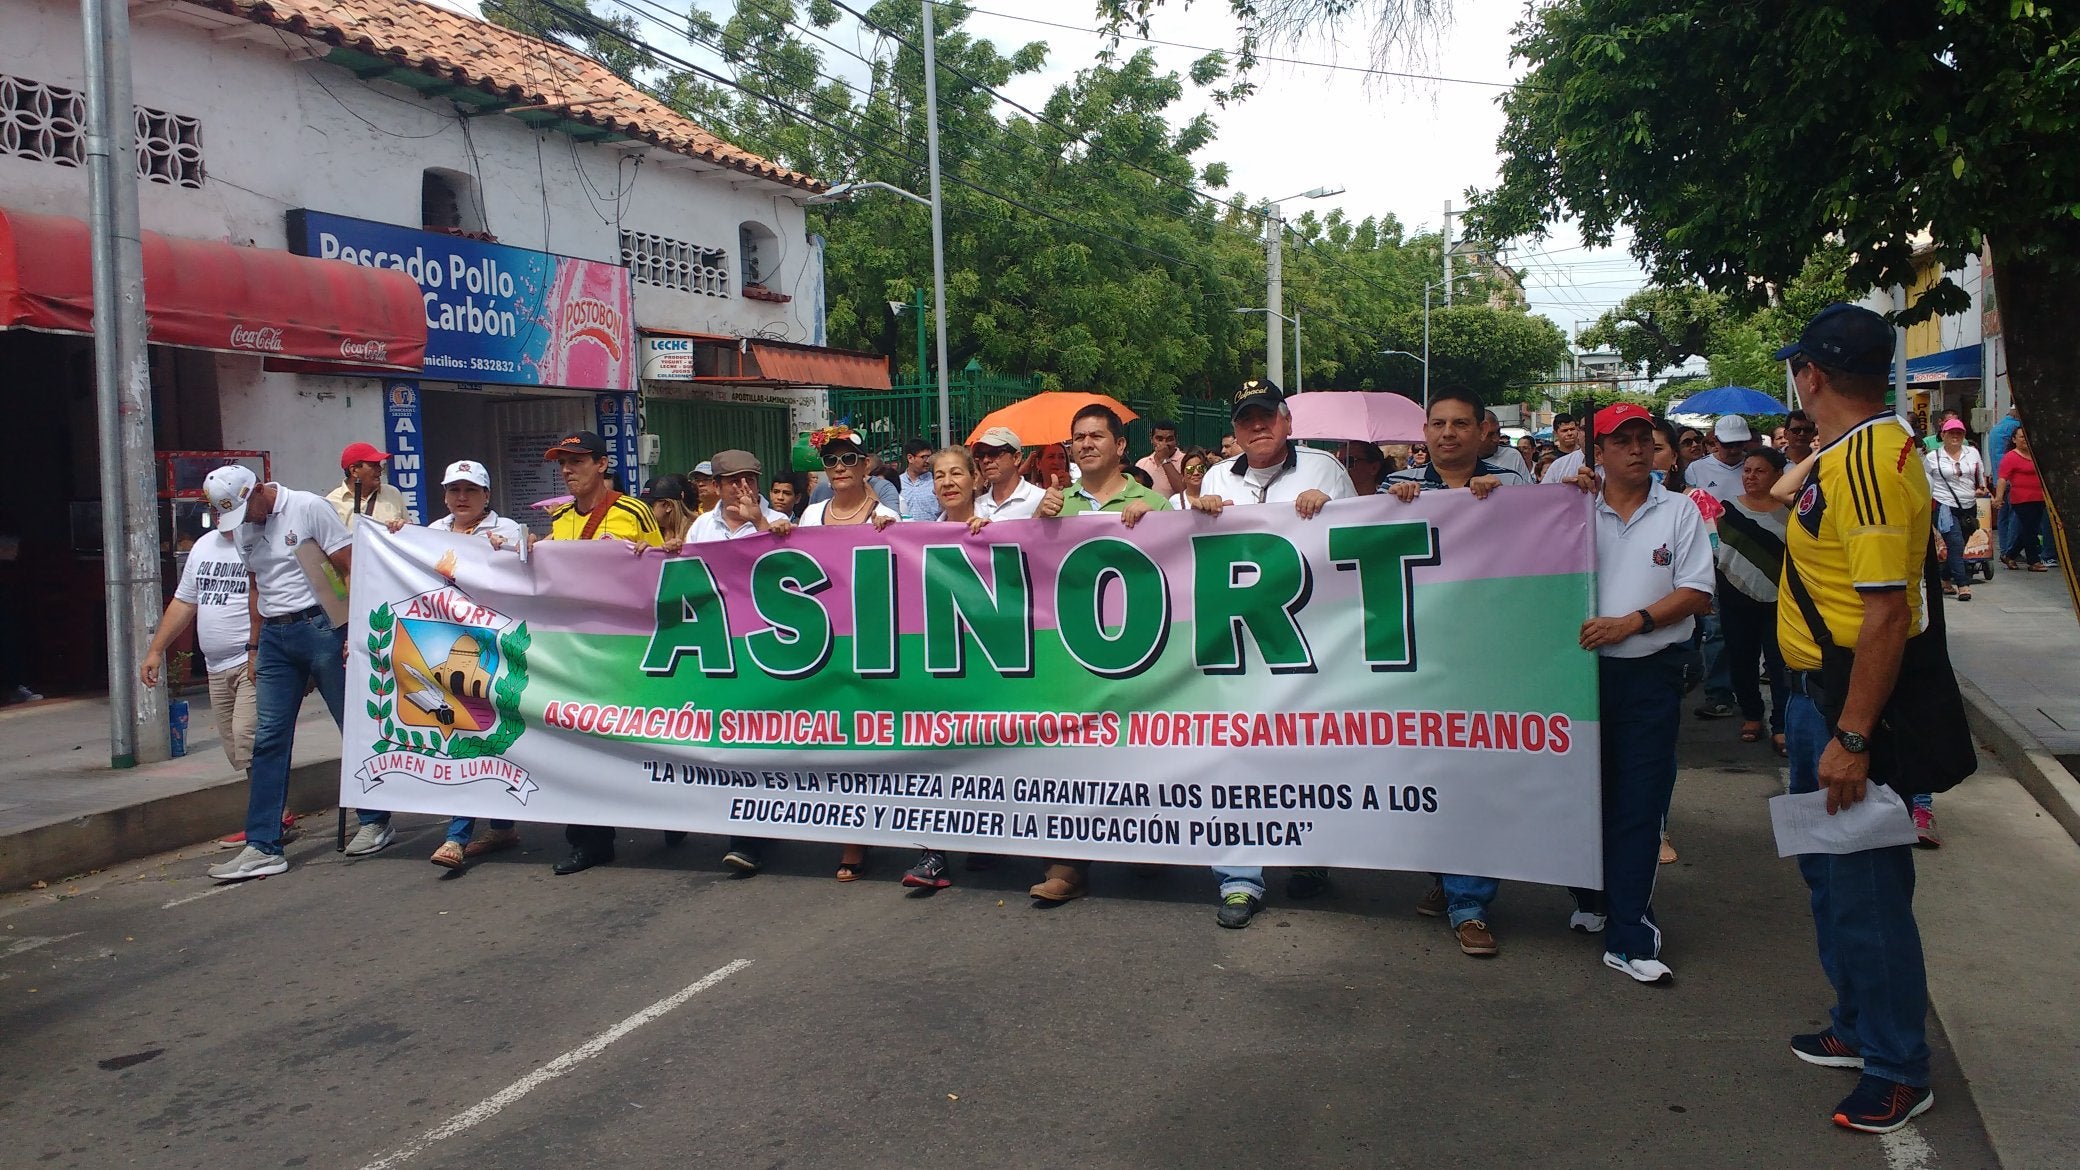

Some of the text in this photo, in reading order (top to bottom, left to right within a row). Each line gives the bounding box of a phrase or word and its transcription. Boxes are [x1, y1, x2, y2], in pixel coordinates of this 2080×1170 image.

[449, 254, 514, 298] Pollo
[423, 292, 515, 337] Carbón
[565, 300, 621, 339] POSTOBON
[470, 357, 514, 373] 5832832
[651, 340, 688, 351] LECHE
[394, 417, 420, 525] ALMUER
[625, 424, 638, 497] ALMUE
[196, 577, 246, 593] TERRITORIO
[197, 561, 213, 575] COL
[201, 592, 229, 605] DE PAZ
[405, 591, 497, 627] ASINORT
[640, 519, 1441, 680] ASINORT
[544, 701, 1571, 754] ASOCIACIÓN SINDICAL DE INSTITUTORES NORTESANTANDEREANOS
[369, 754, 523, 784] LUMEN DE LUMINE
[682, 764, 757, 788] UNIDAD
[764, 770, 789, 790] ES
[796, 771, 820, 792] LA
[827, 772, 943, 798] FORTALEZA
[951, 775, 1005, 801] PARA
[1013, 777, 1150, 807] GARANTIZAR
[1158, 783, 1202, 809] LOS
[1211, 784, 1352, 810] DERECHOS
[1361, 784, 1380, 810] A
[1389, 785, 1439, 813] LOS
[729, 798, 866, 828] EDUCADORES
[872, 805, 887, 830] Y
[891, 807, 1005, 836] DEFENDER
[1011, 813, 1039, 839] LA
[1046, 814, 1180, 845] EDUCACIÓN
